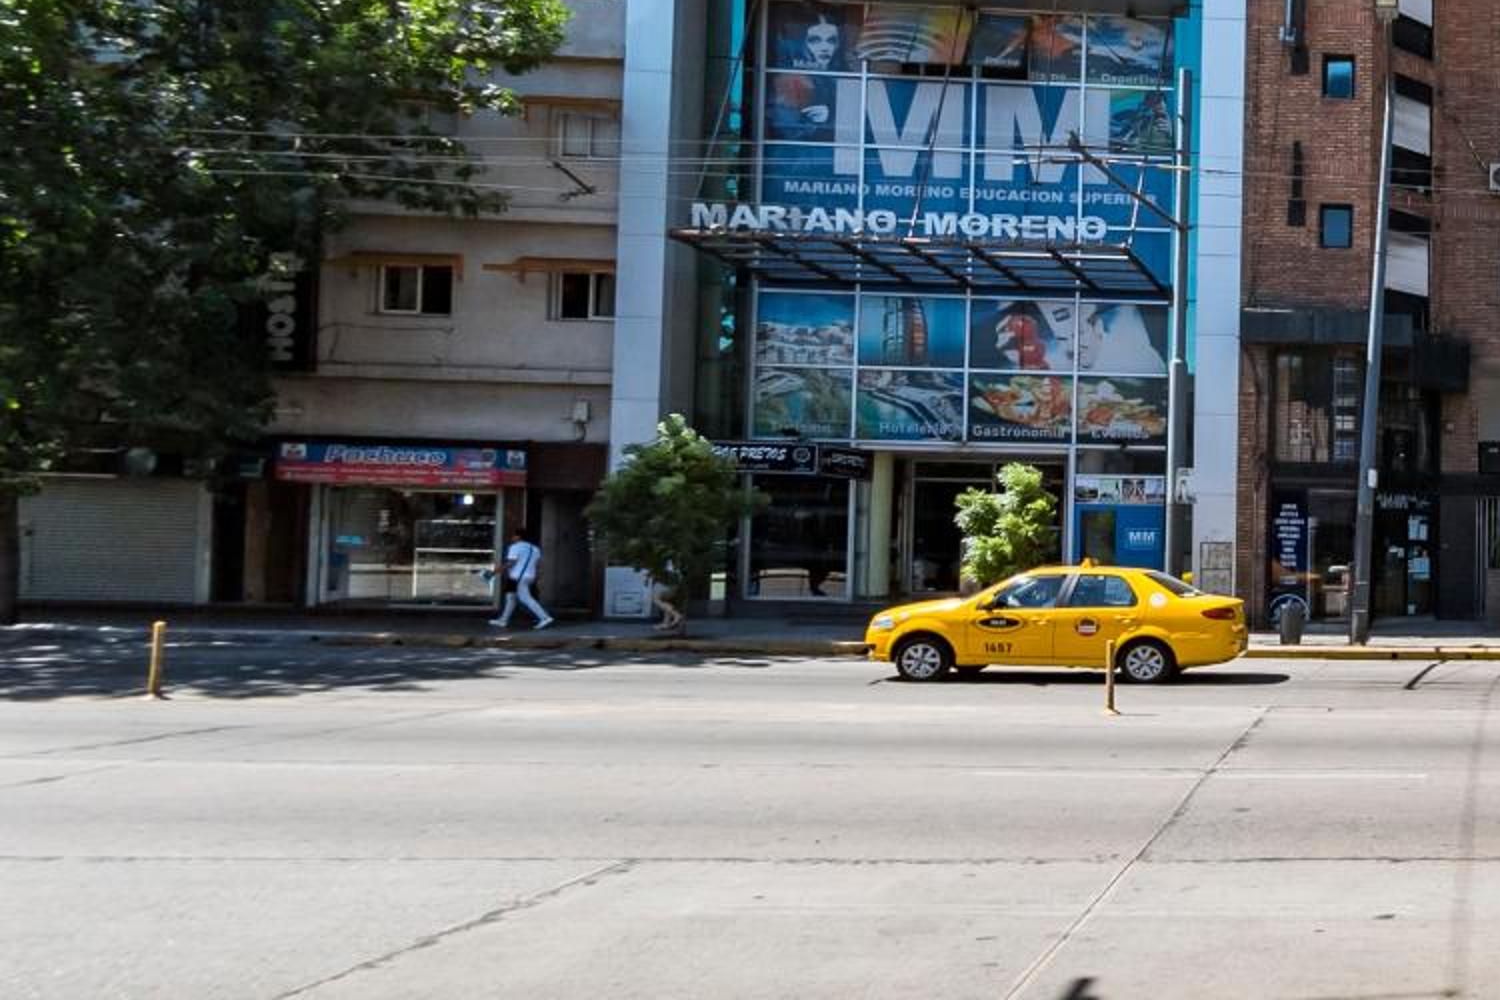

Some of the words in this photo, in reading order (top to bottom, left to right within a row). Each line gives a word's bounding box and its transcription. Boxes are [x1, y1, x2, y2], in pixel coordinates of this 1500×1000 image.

[834, 78, 1109, 184] MM
[784, 181, 869, 198] MARIANO
[960, 187, 1064, 203] EDUCACION
[691, 203, 897, 234] MARIANO
[924, 211, 1107, 240] MORENO
